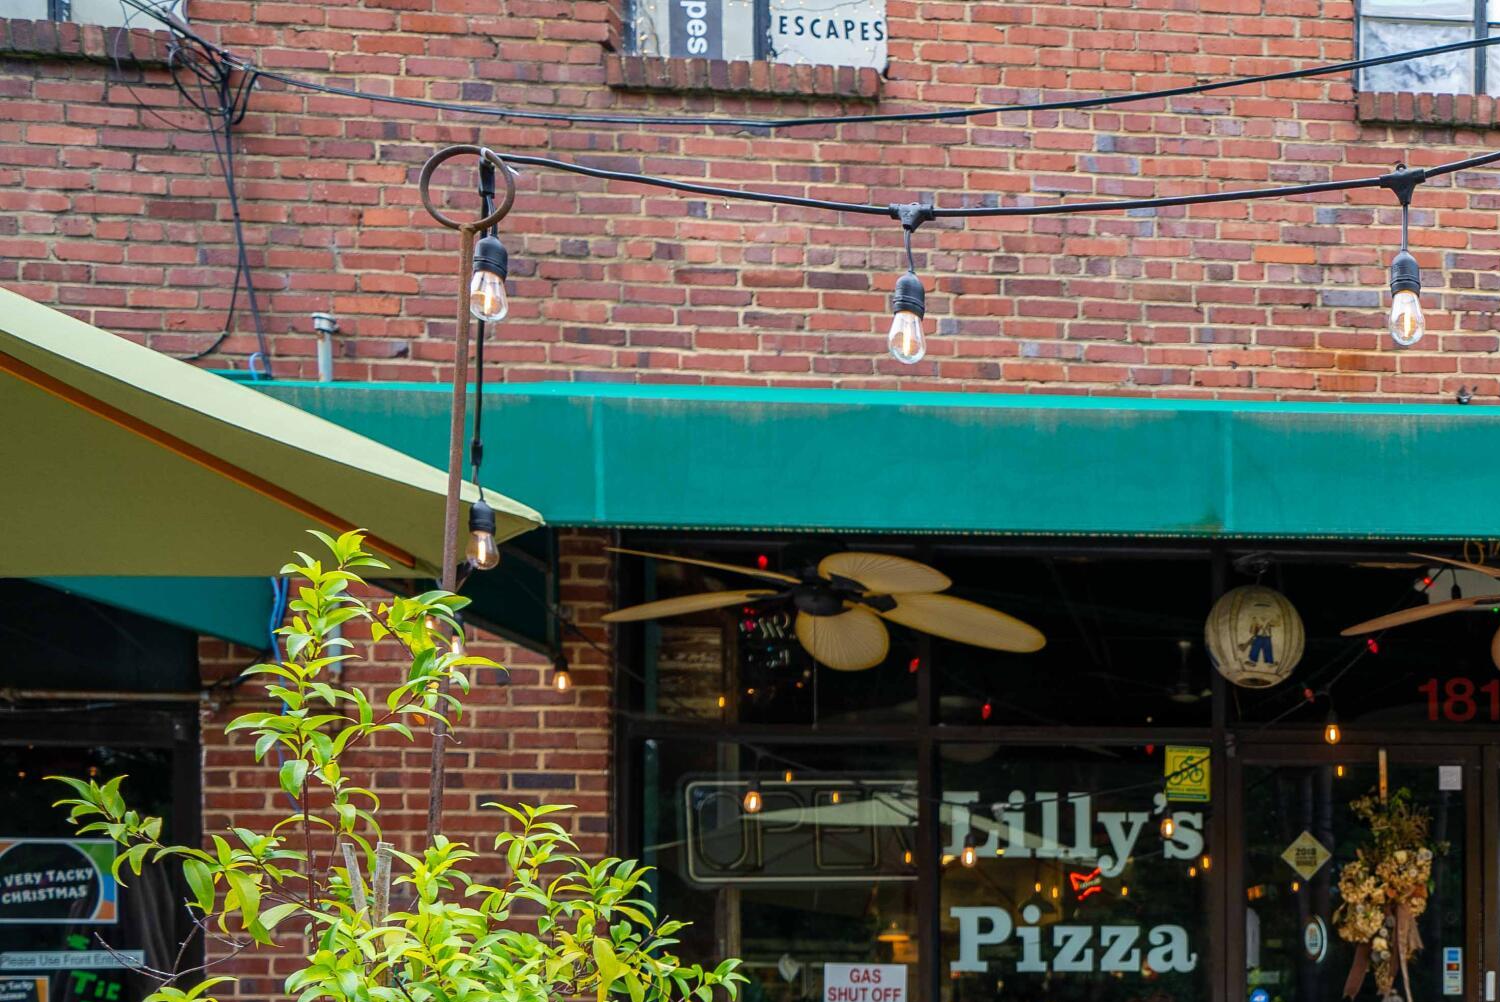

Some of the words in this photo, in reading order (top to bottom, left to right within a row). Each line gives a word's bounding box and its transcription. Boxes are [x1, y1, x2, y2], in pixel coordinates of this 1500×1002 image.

[779, 15, 884, 42] ESCAPES
[942, 790, 1204, 878] Lilly's
[4, 871, 42, 888] VERY
[46, 867, 94, 883] TACKY
[1, 884, 88, 904] CHRISTMAS
[950, 904, 1198, 974] Pizza
[849, 968, 882, 984] GAS
[827, 986, 868, 1002] SHUT
[871, 987, 902, 1002] OFF
